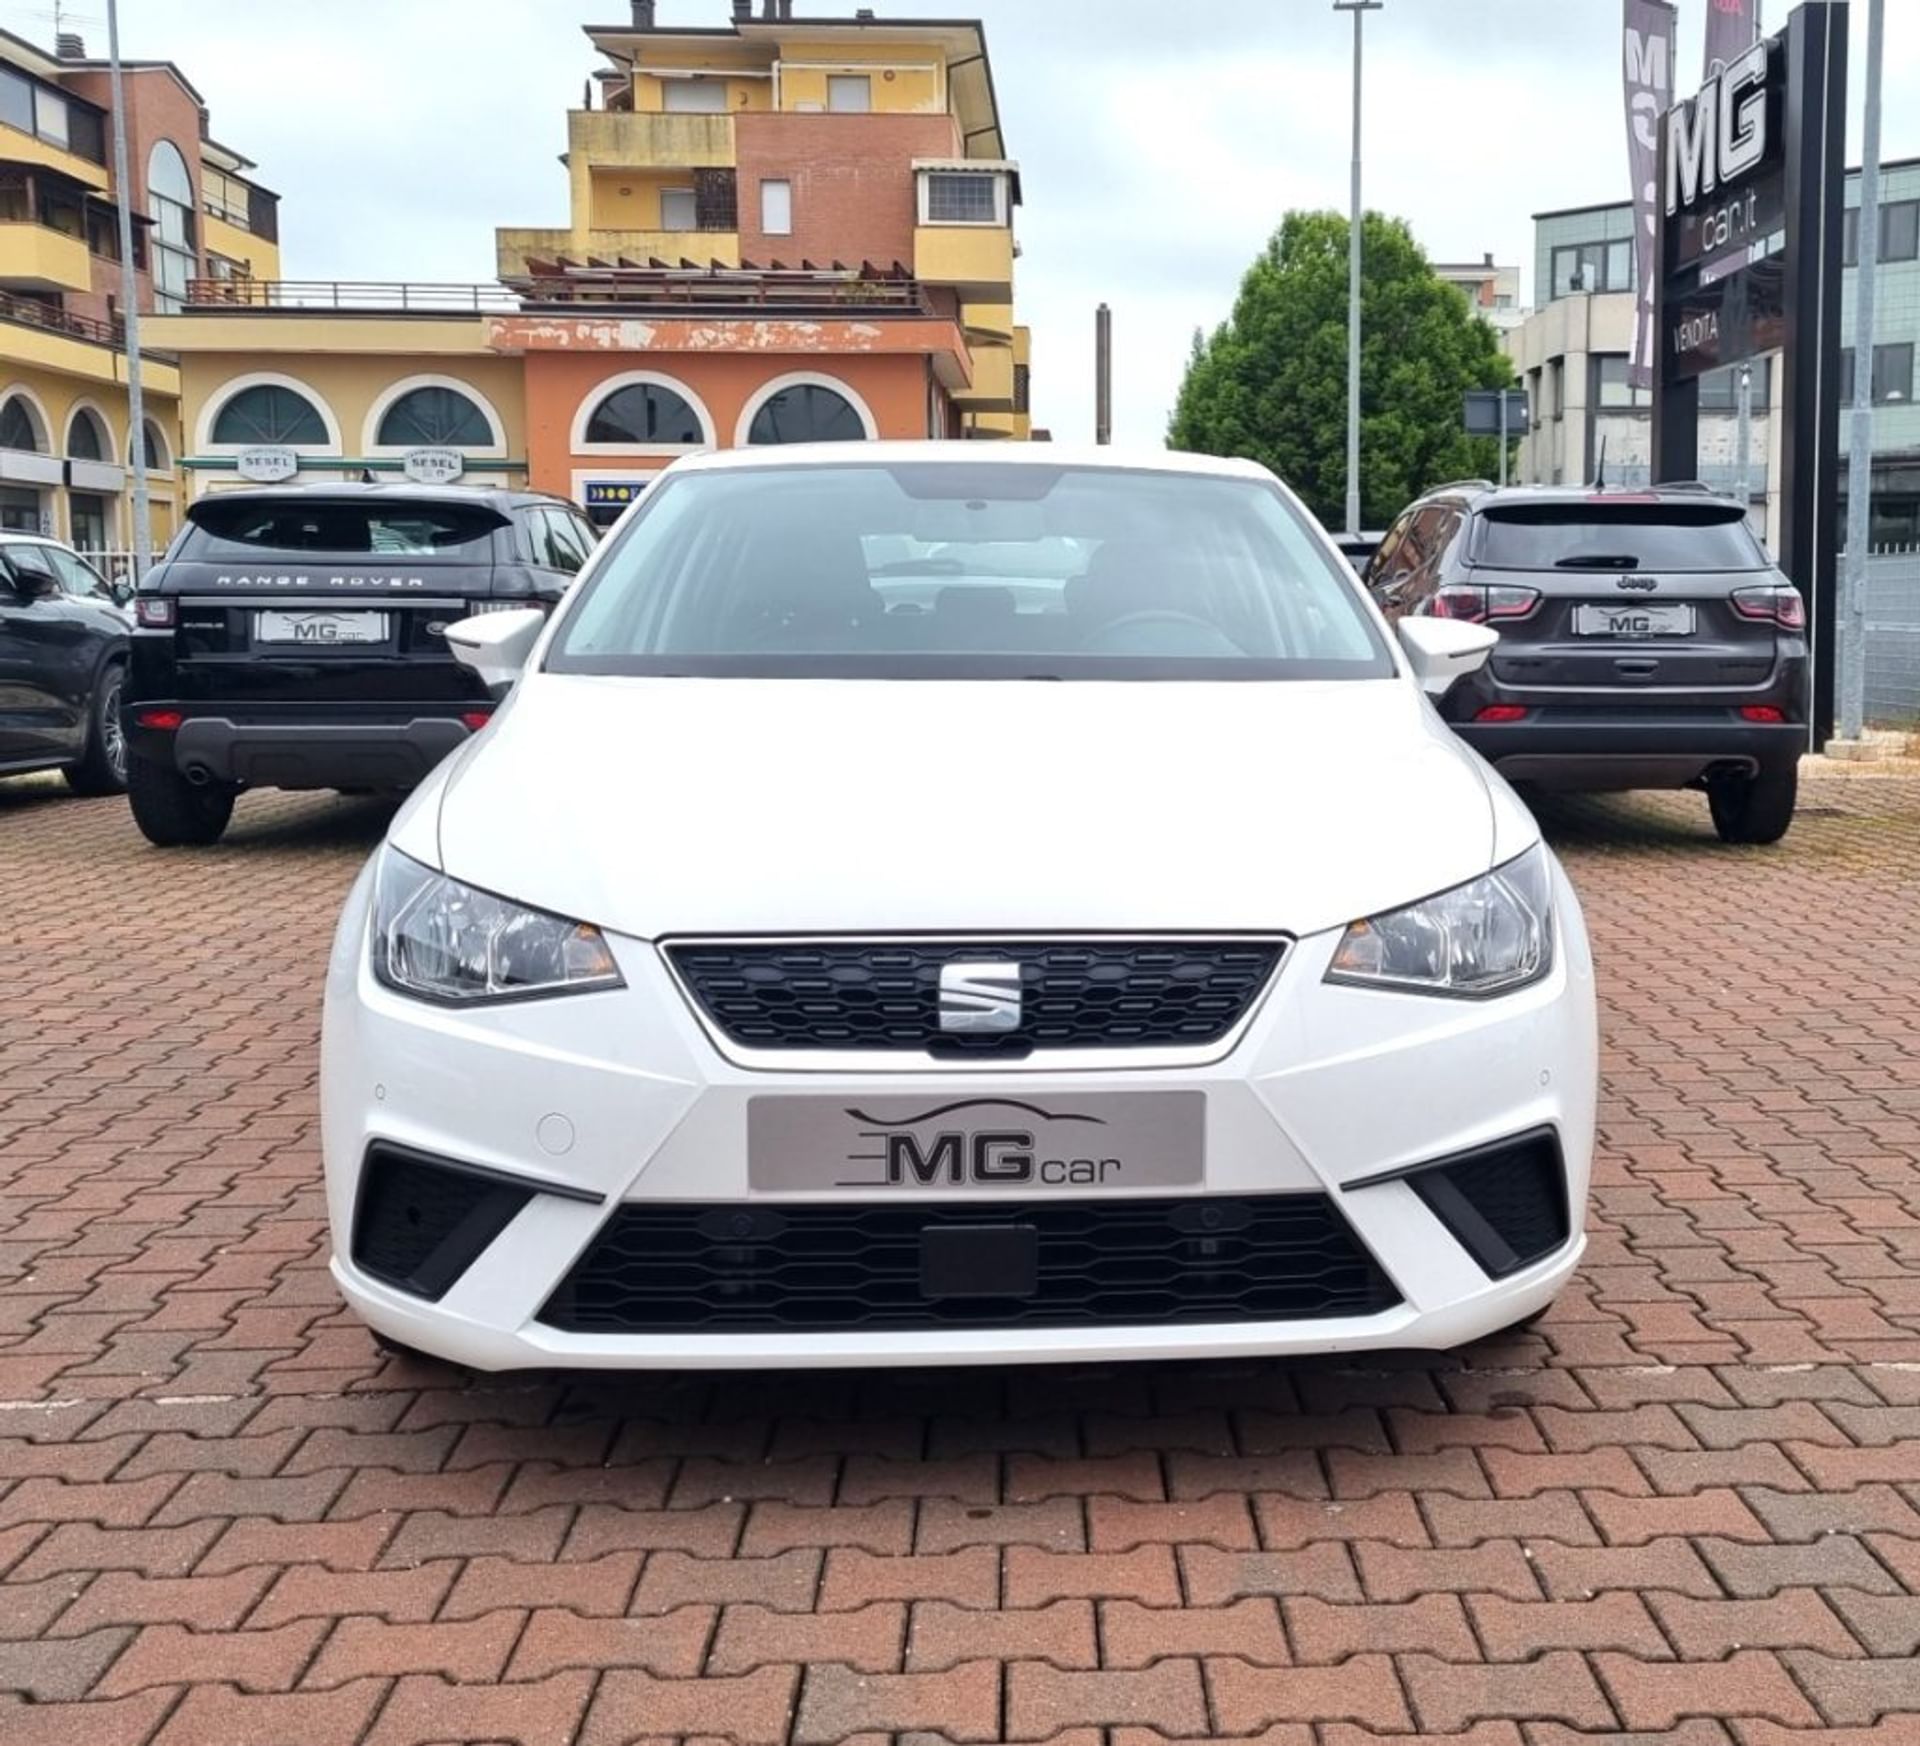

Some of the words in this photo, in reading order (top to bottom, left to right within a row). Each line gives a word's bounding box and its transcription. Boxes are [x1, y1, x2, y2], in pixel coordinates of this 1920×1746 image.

[1665, 36, 1768, 217] MG
[1702, 187, 1757, 252] car.it
[1673, 311, 1719, 354] VENDITA
[216, 575, 310, 586] RANGE
[329, 576, 423, 587] ROVER
[1616, 575, 1659, 592] Jeep
[293, 623, 339, 640] MG
[1608, 616, 1650, 632] MG
[886, 1129, 1035, 1186] MG
[1040, 1155, 1121, 1186] car
